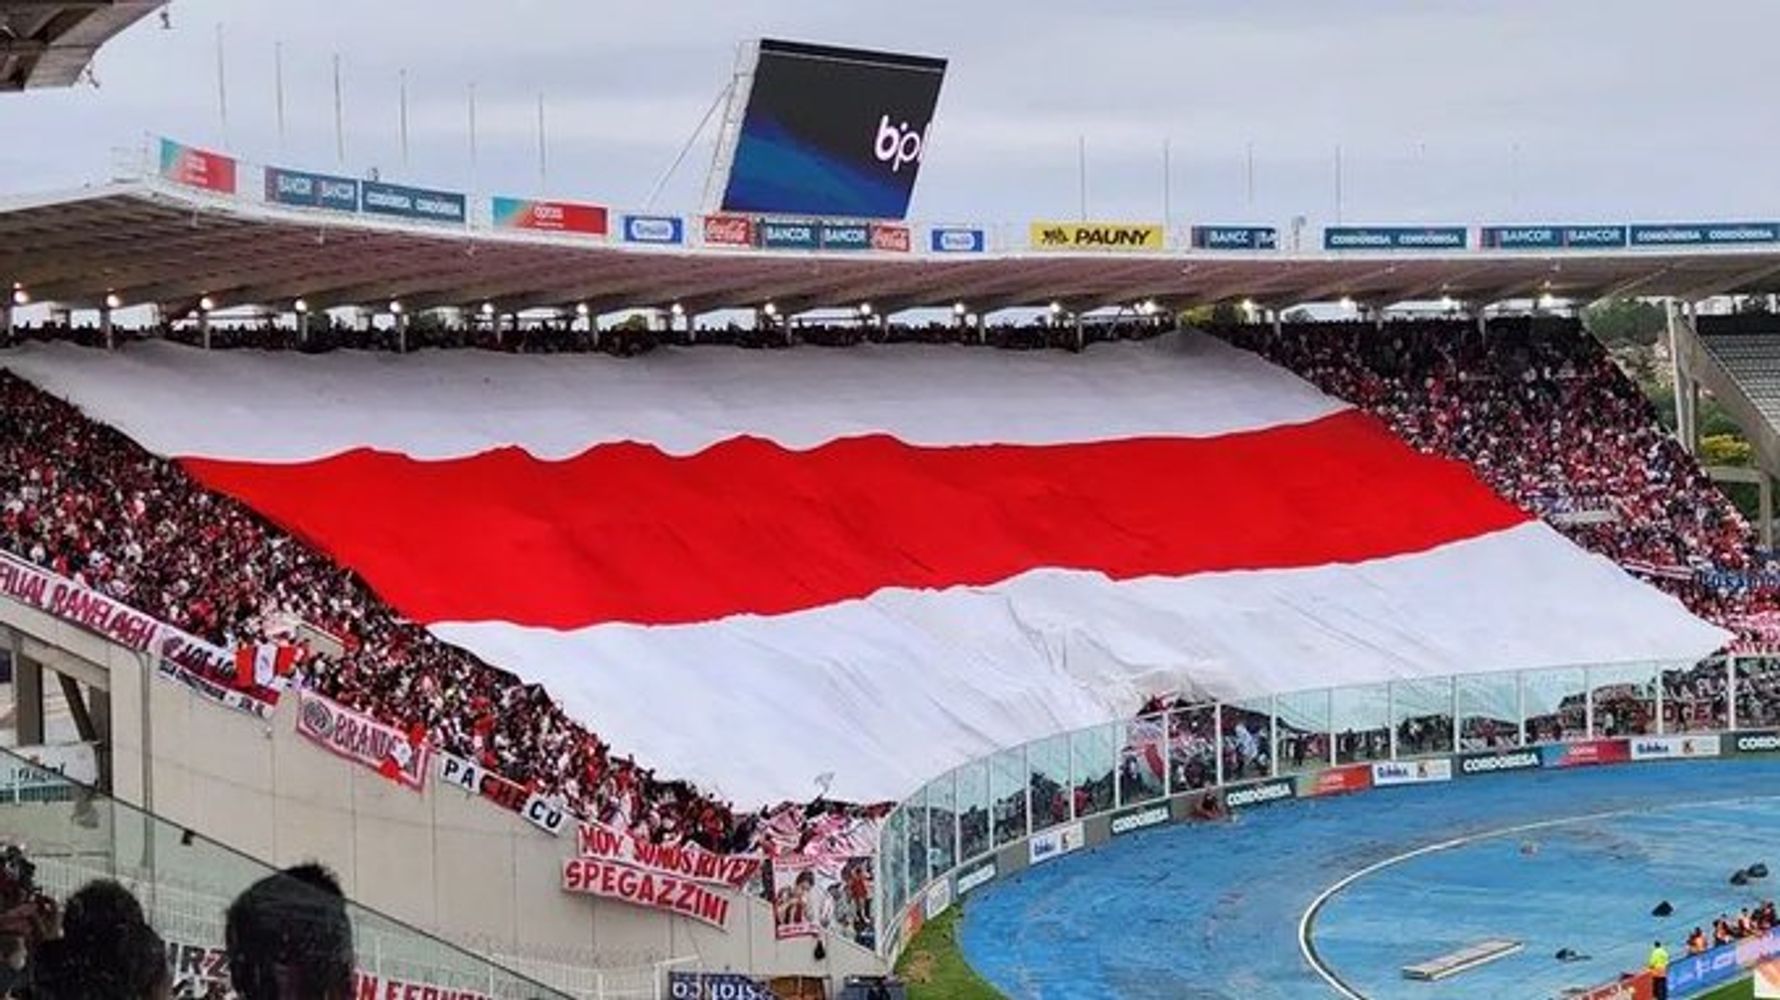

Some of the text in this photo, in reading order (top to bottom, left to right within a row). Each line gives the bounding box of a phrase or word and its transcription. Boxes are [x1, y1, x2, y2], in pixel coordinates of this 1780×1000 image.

[766, 227, 865, 243] BANCOR BANCOR
[1074, 228, 1151, 245] PAUNY
[1502, 229, 1620, 242] BANCOR BANCOR
[1463, 754, 1538, 772] CORDOBESA
[565, 860, 729, 925] SPEGAZZINI
